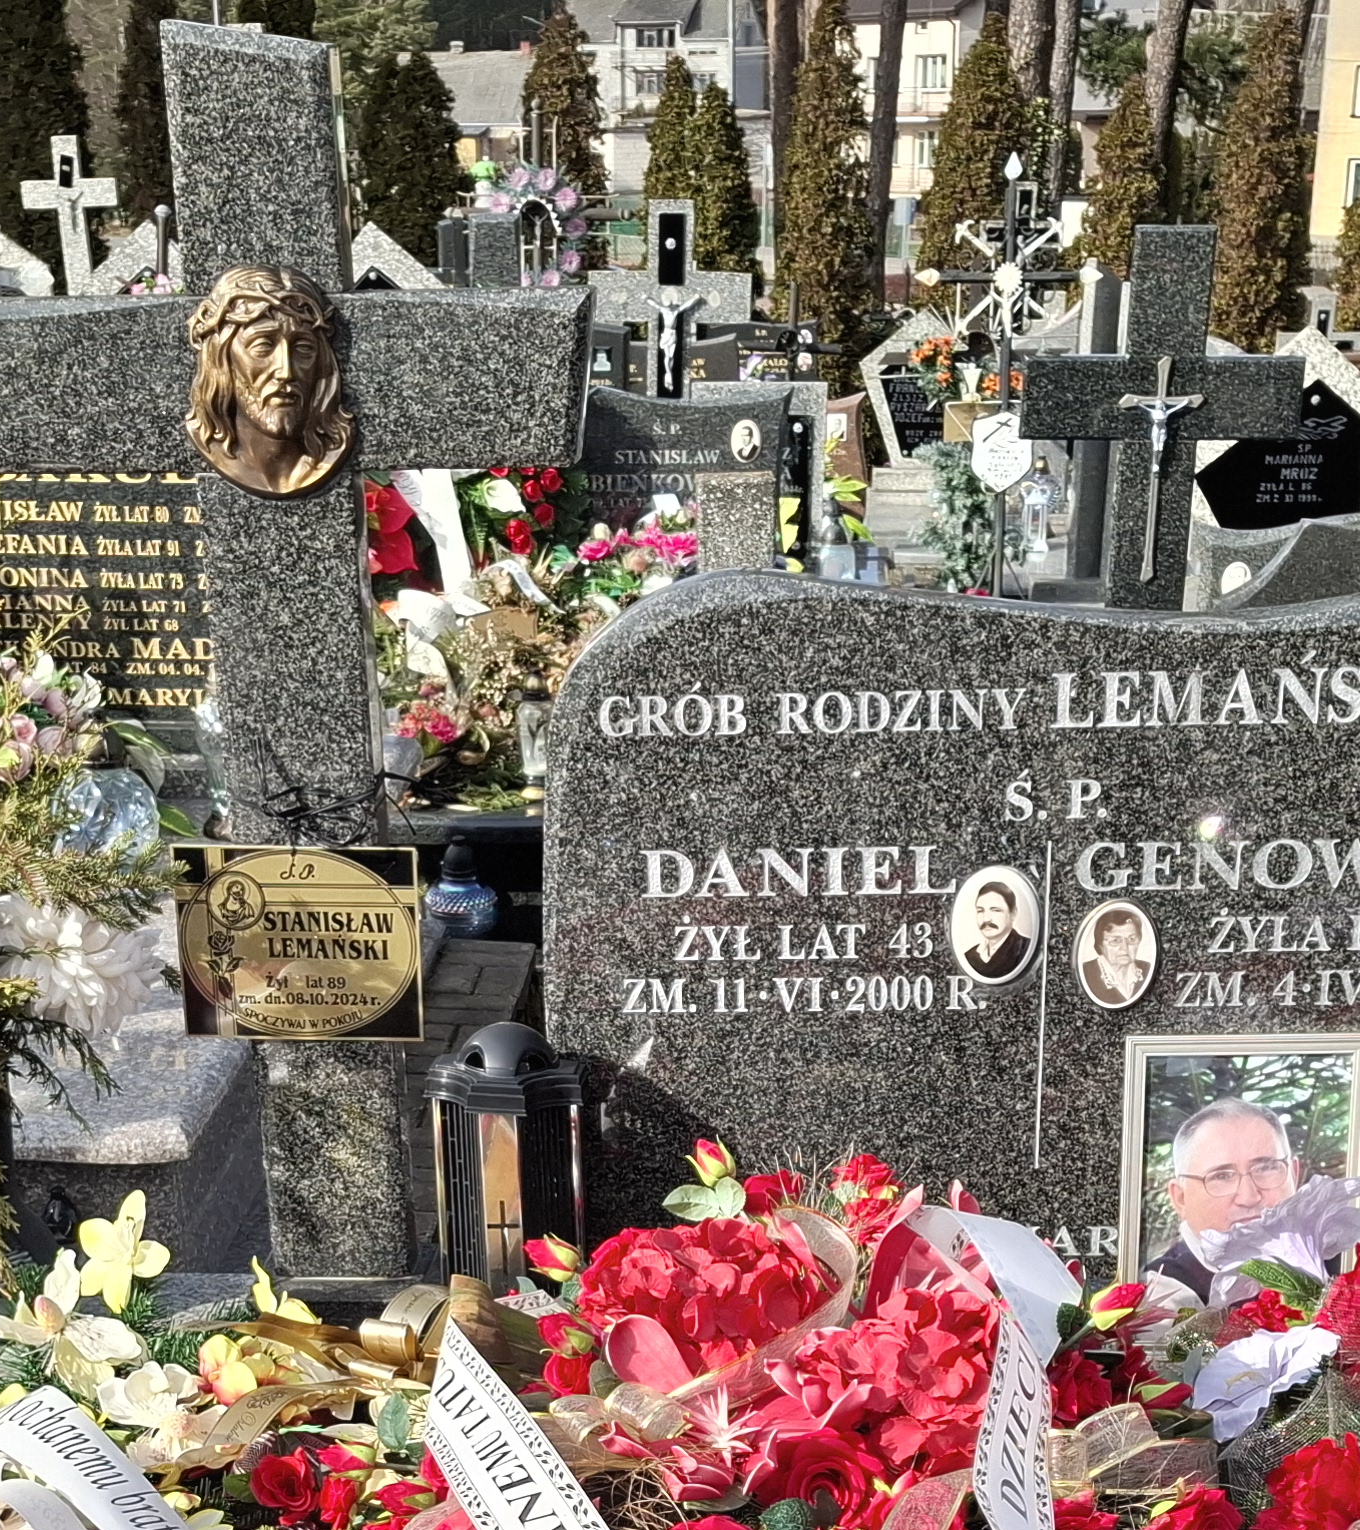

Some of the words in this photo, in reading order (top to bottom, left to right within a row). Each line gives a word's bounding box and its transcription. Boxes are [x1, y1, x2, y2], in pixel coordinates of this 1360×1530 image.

[1264, 454, 1324, 465] MARIANNA
[125, 505, 150, 523] LAT
[136, 539, 161, 557] LAT
[167, 540, 181, 557] 91
[139, 572, 165, 590] LAT
[142, 600, 168, 613] LAT
[133, 619, 159, 632] LAT
[599, 681, 748, 738] GRÓB
[775, 686, 1027, 736] RODZINY
[1004, 769, 1048, 822] Ś.
[1065, 778, 1109, 820] P.
[639, 844, 957, 899] DANIEL
[263, 910, 395, 935] STANISŁAW
[1208, 906, 1332, 955] ŻYŁA
[267, 933, 390, 961] LEMAŃSKI
[673, 914, 762, 961] ŻYŁ
[776, 922, 868, 962] LAT
[887, 920, 936, 961] 43
[265, 971, 290, 991] Żył
[306, 975, 324, 990] lat
[327, 976, 347, 990] 89
[1172, 969, 1257, 1009] ZM.
[239, 994, 261, 1006] zm.
[369, 996, 382, 1007] r.
[622, 976, 698, 1015] ZM.
[945, 973, 988, 1013] R.
[243, 1007, 306, 1030] SPOCZYWAJ
[308, 1018, 322, 1030] W
[321, 1009, 364, 1029] POKOJU
[999, 1336, 1038, 1524] DZIECI
